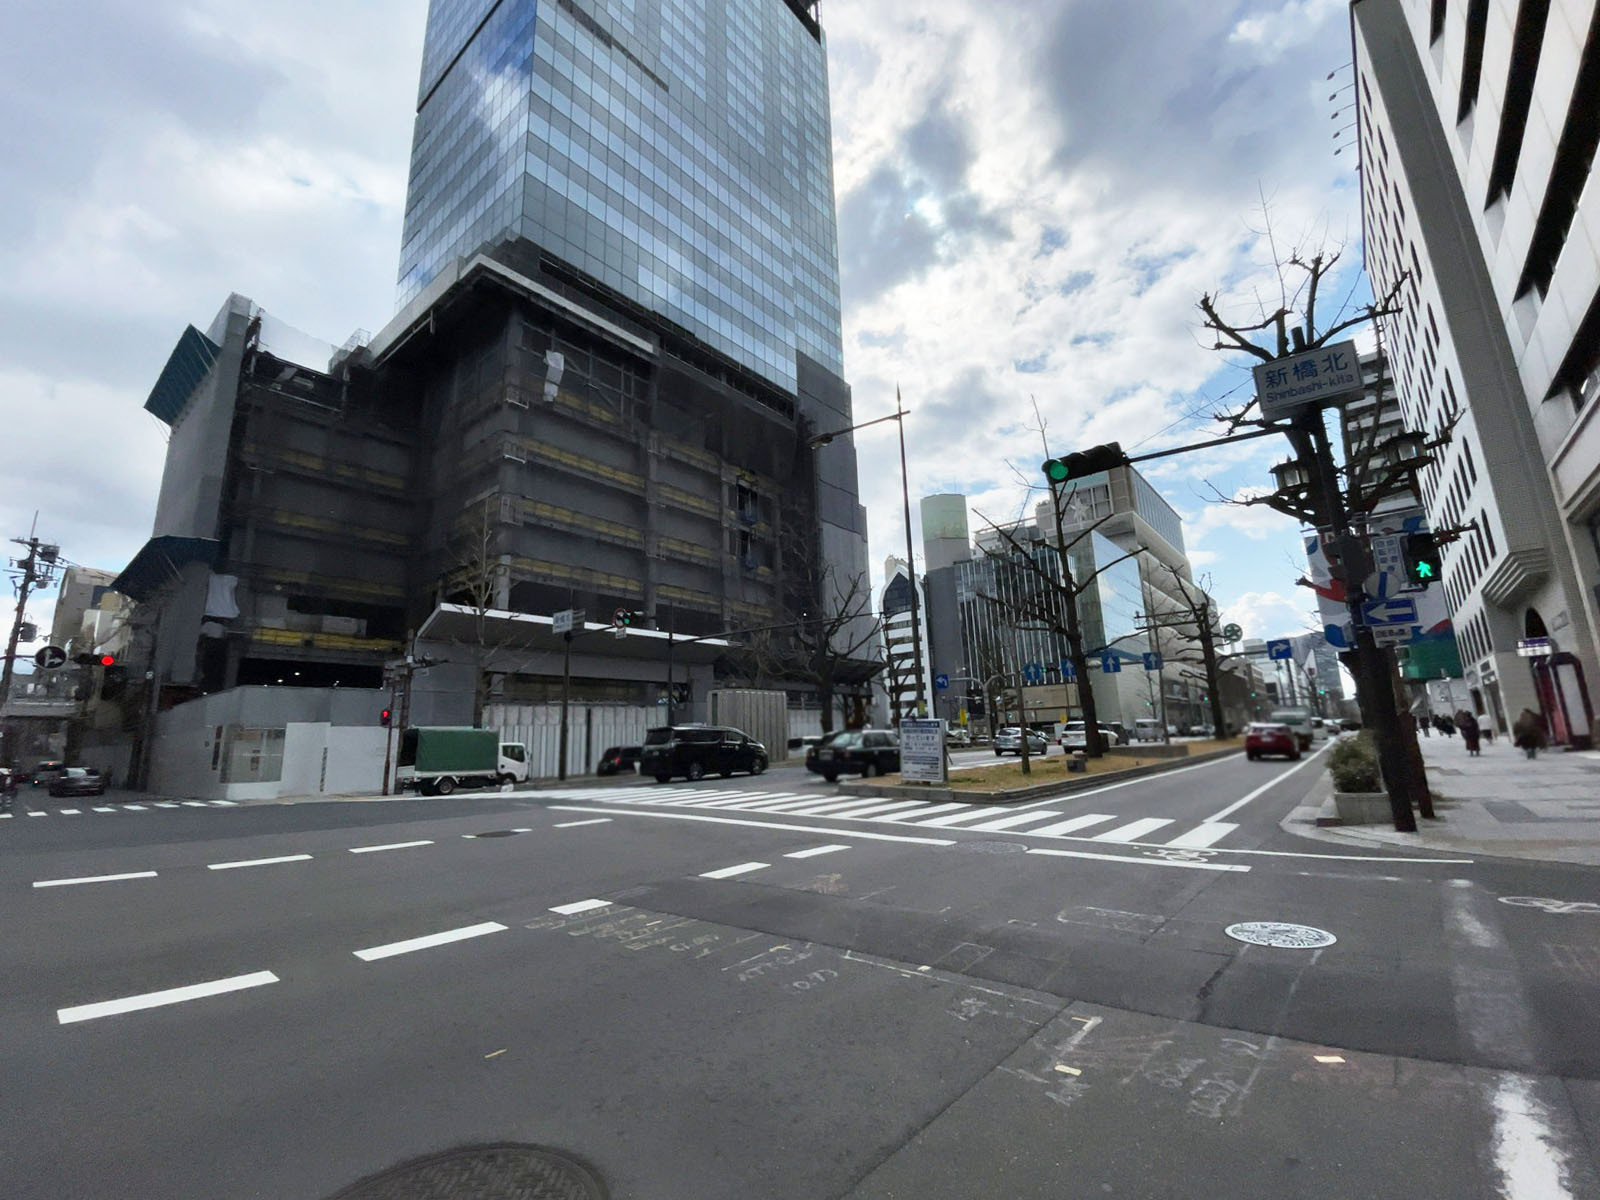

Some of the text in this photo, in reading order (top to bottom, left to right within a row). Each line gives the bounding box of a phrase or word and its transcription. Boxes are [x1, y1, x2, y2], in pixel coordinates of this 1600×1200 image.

[1265, 352, 1348, 388] 新橋北
[1266, 374, 1354, 403] Shinbashi-kita
